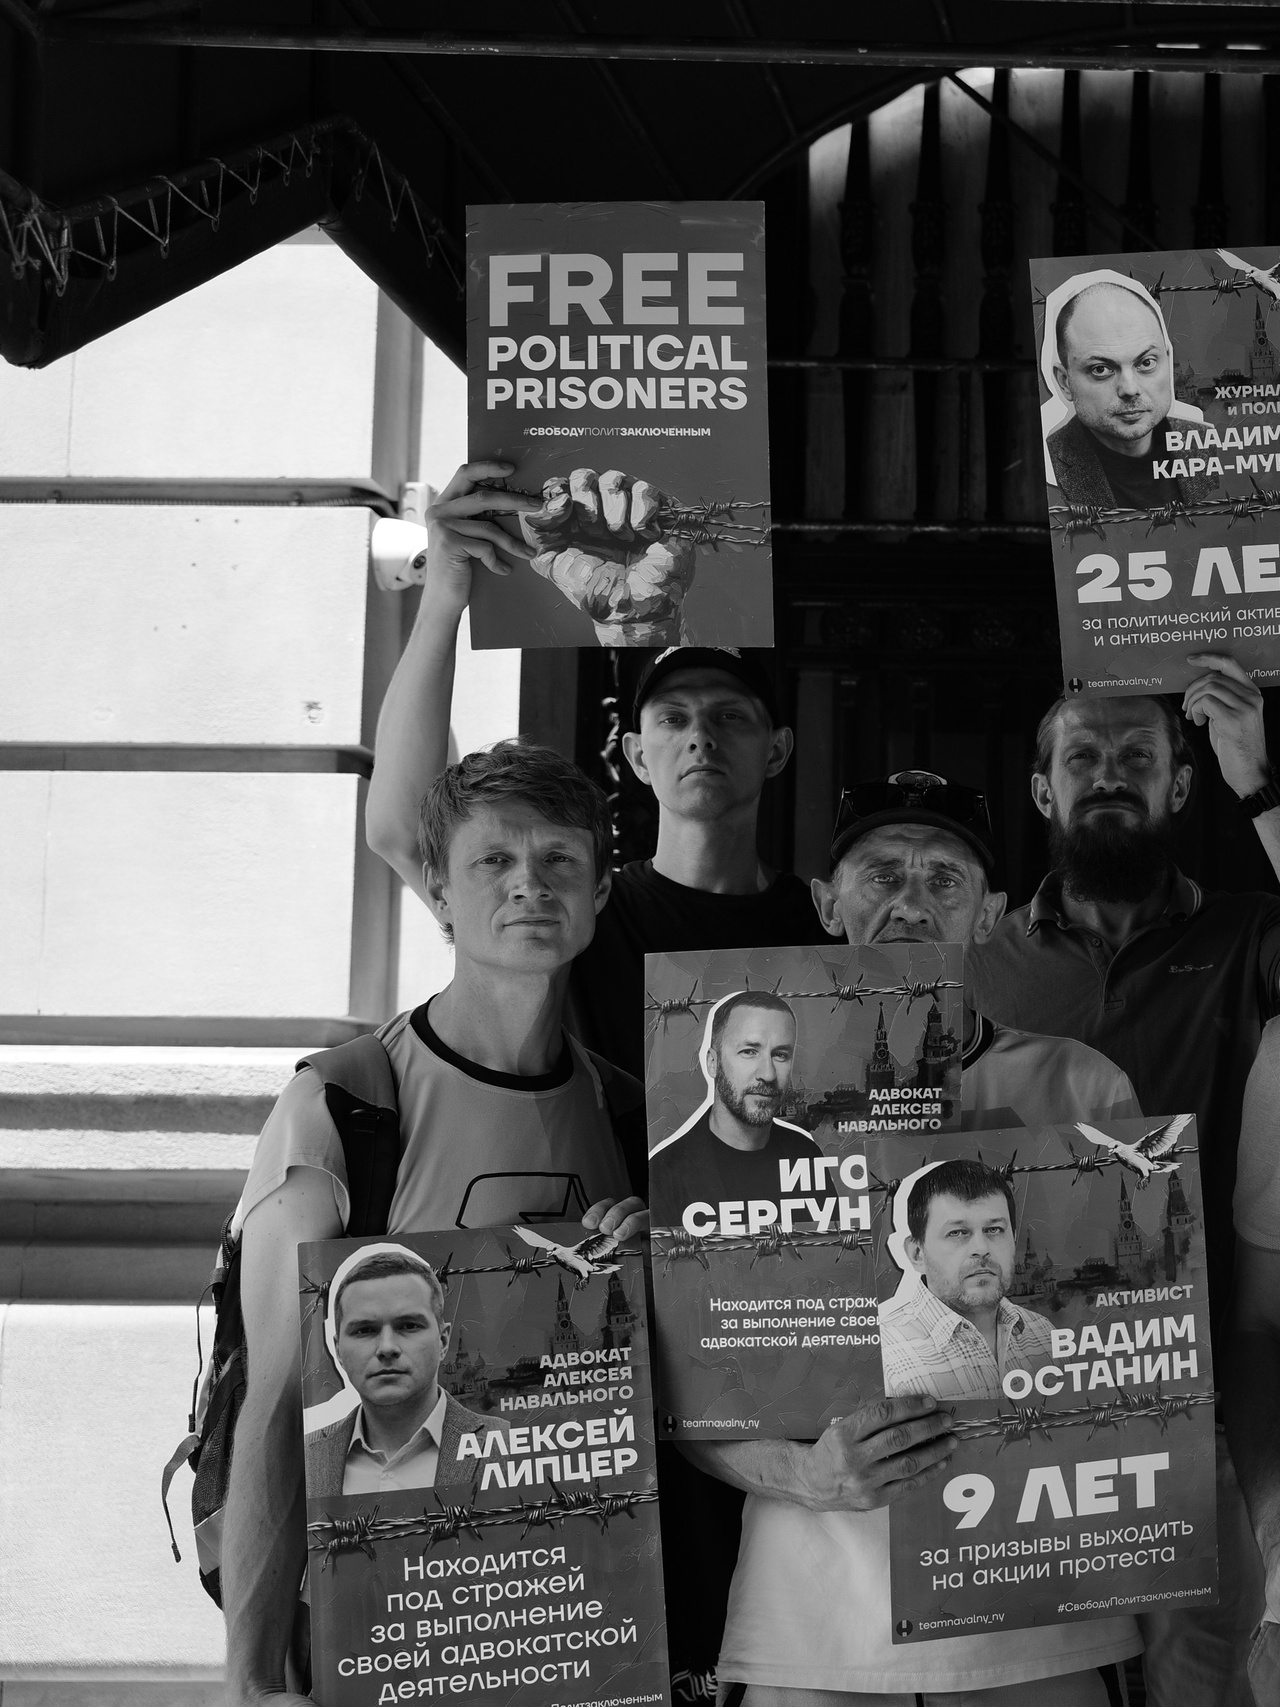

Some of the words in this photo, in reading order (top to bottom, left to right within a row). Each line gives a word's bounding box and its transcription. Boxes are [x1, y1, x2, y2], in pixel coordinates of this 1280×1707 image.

[489, 253, 744, 326] FREE
[489, 335, 747, 371] POLITICAL
[487, 377, 747, 410] PRISONERS
[523, 426, 711, 437] #СВОБОДУПОЛИТЗАКЛЮЧЕННЫМ
[1076, 551, 1172, 603] 25
[1083, 619, 1101, 630] за
[1108, 606, 1230, 628] политический
[1095, 636, 1103, 646] и
[1110, 628, 1227, 645] антивоенную
[1088, 677, 1162, 687] teamnavalny_ny
[869, 1088, 942, 1101] АДВОКАТ
[871, 1104, 941, 1115] АЛЕКСЕЯ
[838, 1119, 941, 1134] НАВАЛЬНОГО
[711, 1298, 791, 1312] Находится
[797, 1298, 825, 1311] под
[829, 1298, 877, 1311] страж
[1096, 1285, 1193, 1307] АКТИВИСТ
[721, 1319, 737, 1329] за
[743, 1317, 835, 1328] выполнение
[701, 1332, 797, 1349] адвокатской
[1051, 1314, 1196, 1358] ВАДИМ
[540, 1347, 631, 1369] АДВОКАТ
[544, 1366, 632, 1387] АЛЕКСЕЯ
[1002, 1348, 1198, 1400] ОСТАНИН
[501, 1386, 633, 1411] НАВАЛЬНОГО
[456, 1408, 634, 1460] АЛЕКСЕЙ
[683, 1418, 759, 1429] teamnavalny_ny
[481, 1448, 637, 1490] ЛИПЦЕР
[943, 1474, 995, 1529] 9
[1016, 1452, 1169, 1523] ЛЕТ
[920, 1549, 949, 1566] за
[960, 1536, 1069, 1565] призывы
[1080, 1521, 1193, 1548] выходить
[404, 1547, 565, 1581] Находится
[933, 1573, 963, 1590] на
[973, 1563, 1049, 1585] акции
[1060, 1547, 1174, 1578] протеста
[388, 1590, 443, 1612] под
[452, 1570, 585, 1606] стражей
[1058, 1587, 1211, 1612] #СвободуПолитзаключенным
[371, 1623, 404, 1643] за
[417, 1601, 602, 1638] выполнение
[919, 1613, 1004, 1630] teamnavalny_ny
[338, 1642, 429, 1676] своей
[440, 1618, 637, 1666] адвокатской
[379, 1659, 591, 1706] деятельности
